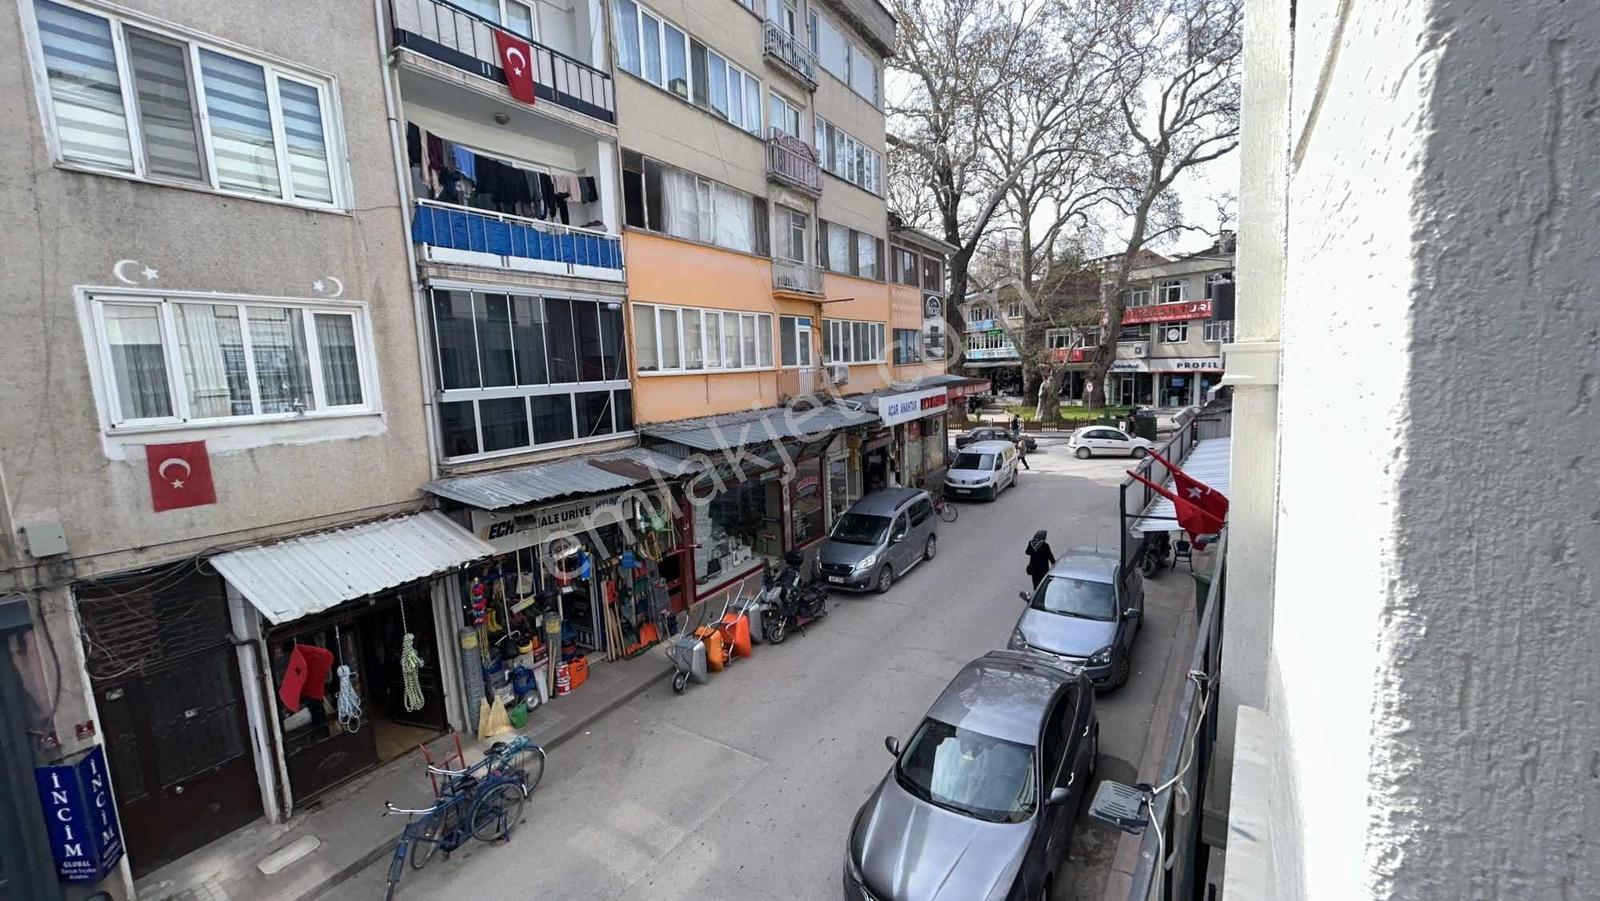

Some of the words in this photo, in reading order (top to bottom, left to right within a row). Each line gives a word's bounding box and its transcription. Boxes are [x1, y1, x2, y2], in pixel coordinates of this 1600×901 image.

[51, 772, 83, 857] İNCİM
[90, 759, 115, 845] İNCİM
[63, 860, 91, 868] GLOBAL
